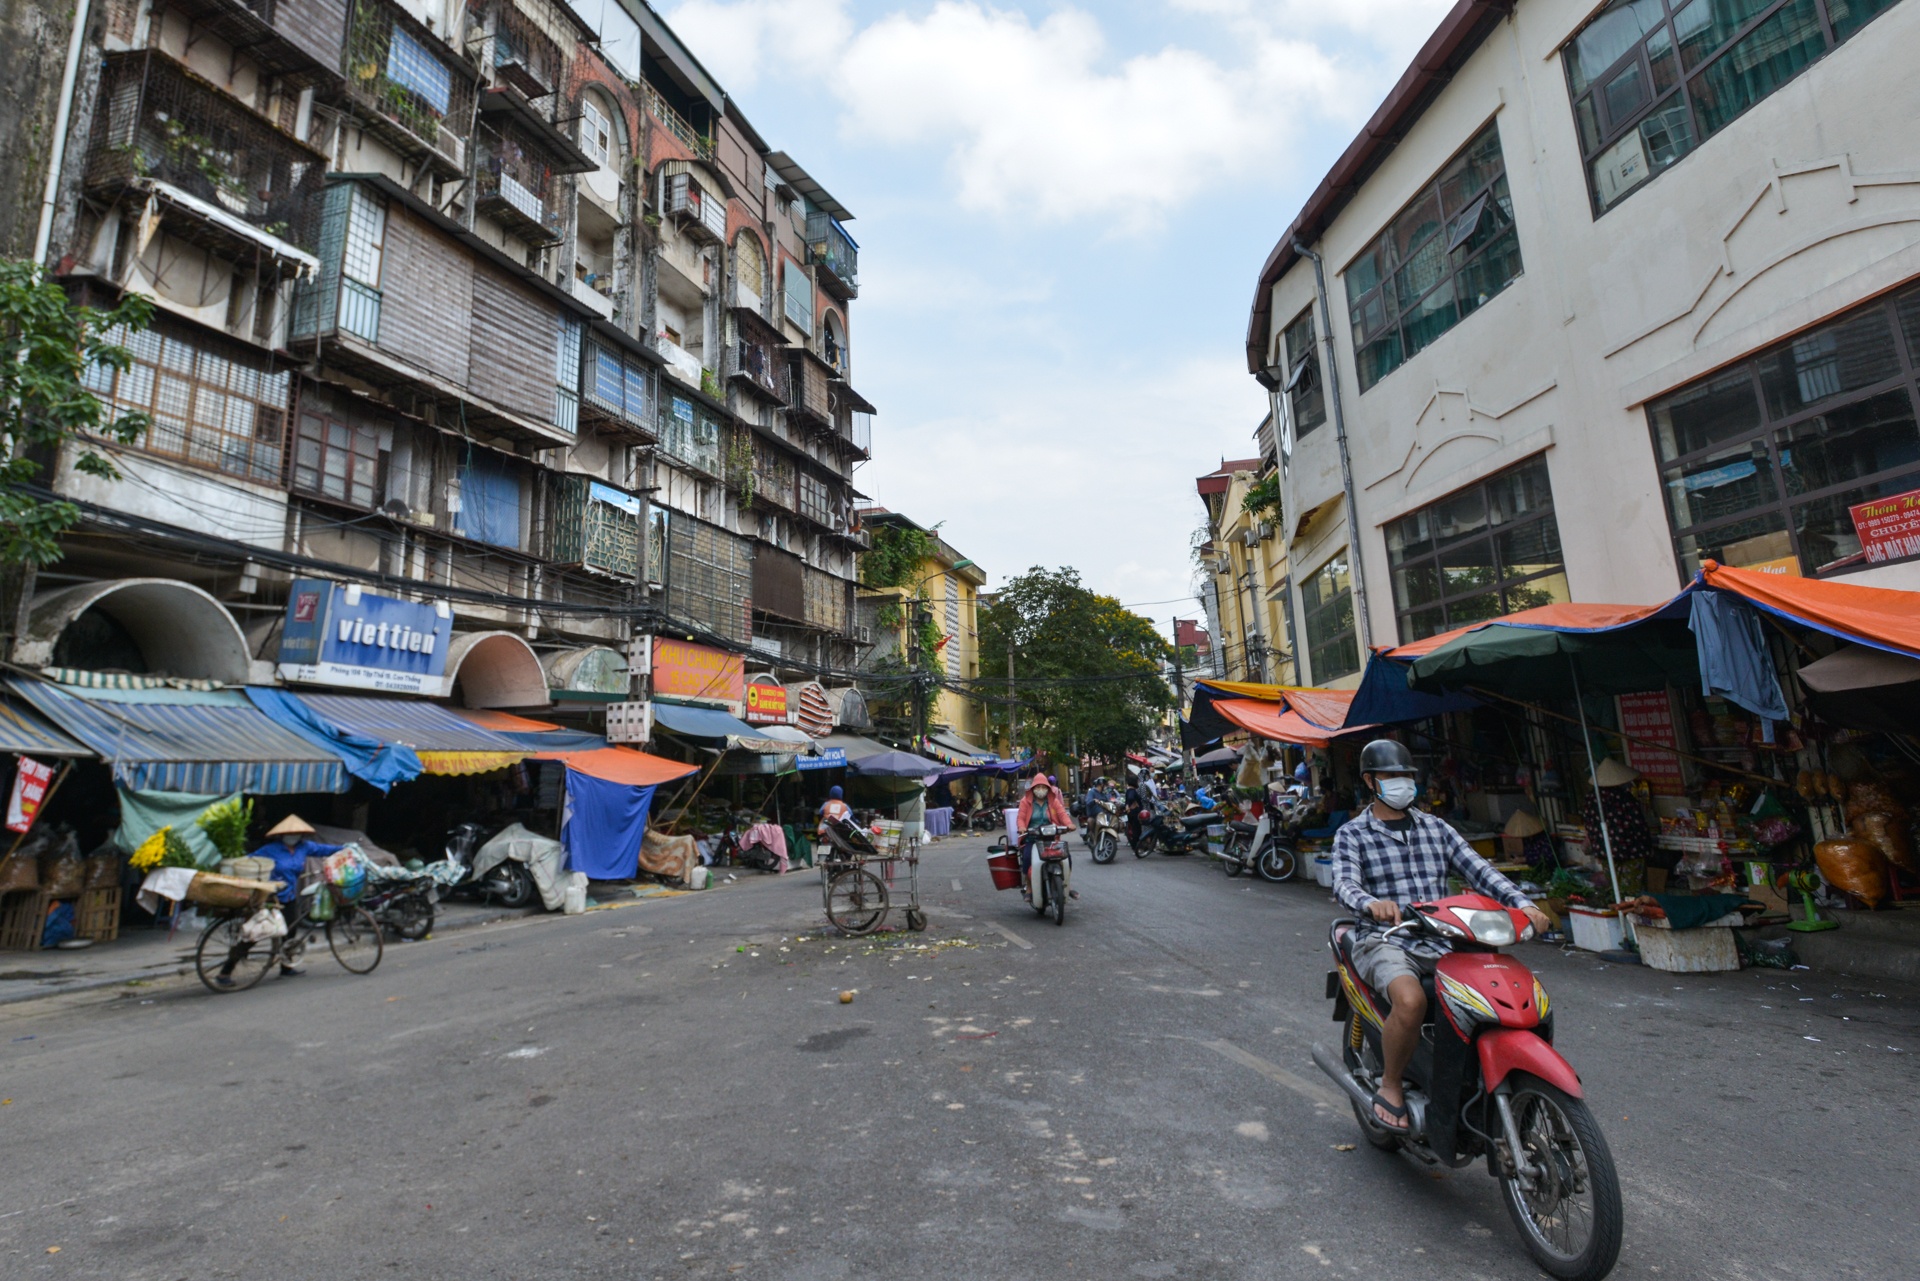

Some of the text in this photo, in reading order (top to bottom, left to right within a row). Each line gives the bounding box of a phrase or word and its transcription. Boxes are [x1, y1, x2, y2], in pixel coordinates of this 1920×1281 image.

[339, 617, 436, 655] viettien
[660, 644, 685, 667] KHU
[687, 647, 723, 672] CHUNG
